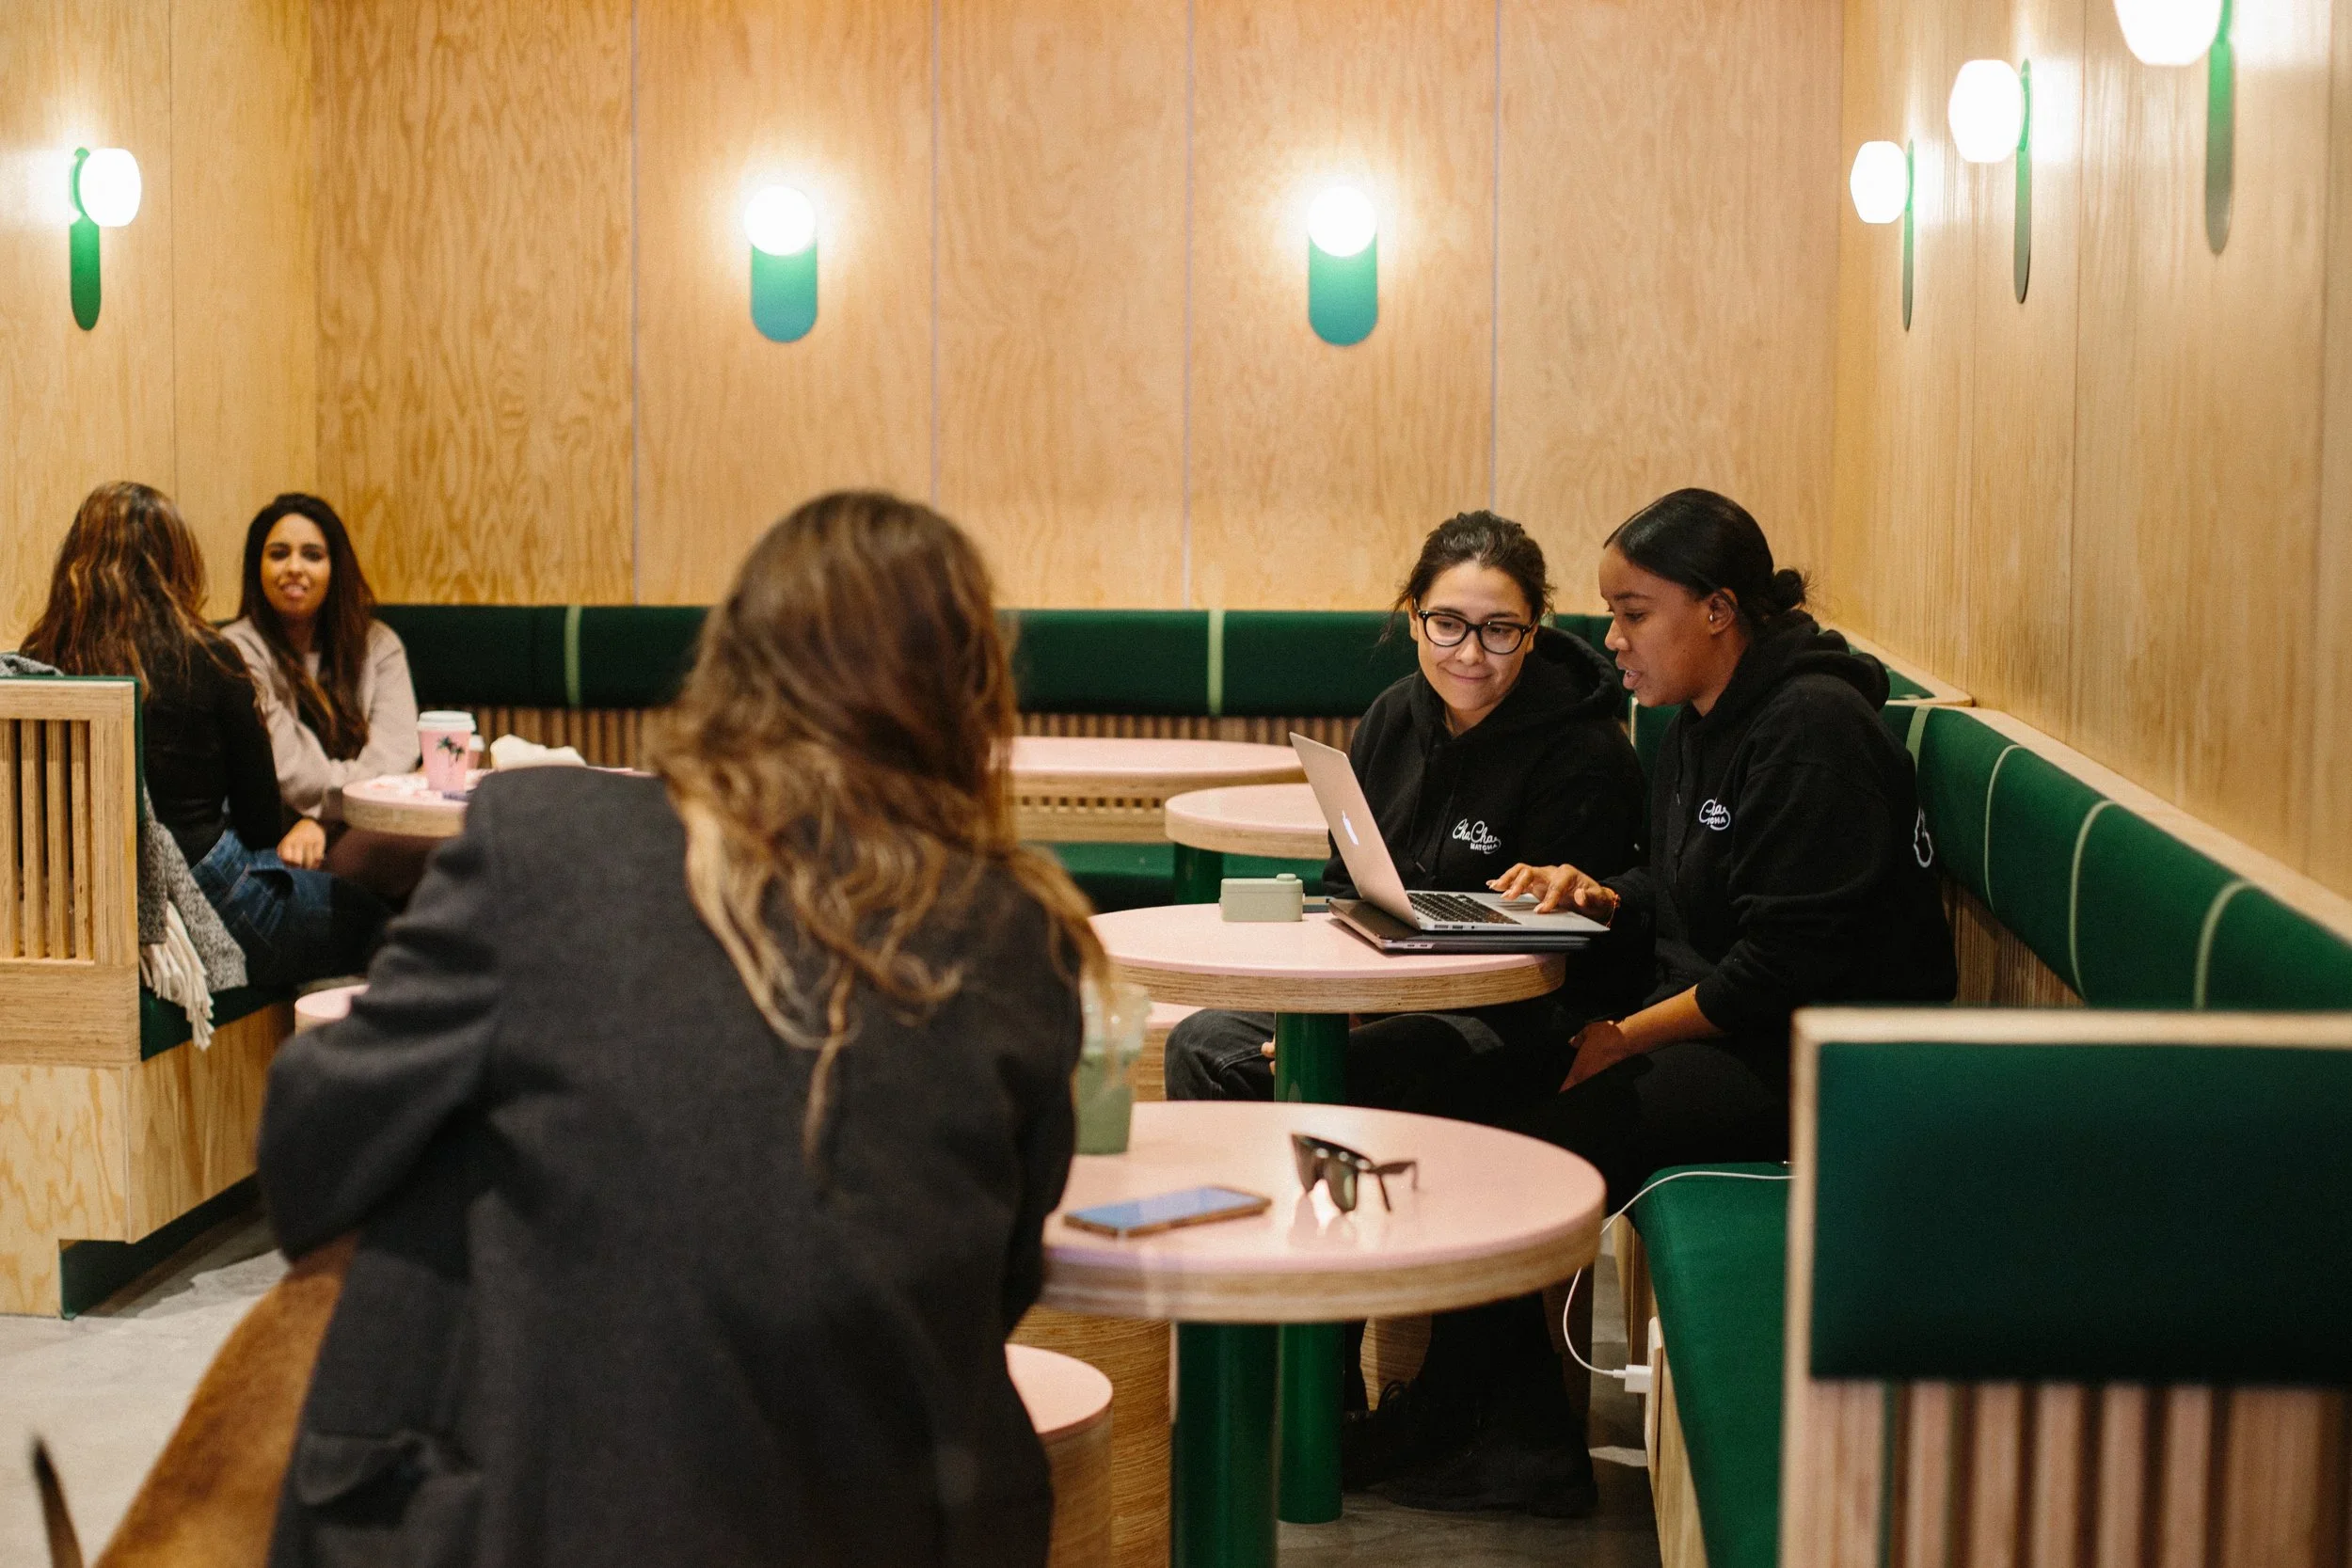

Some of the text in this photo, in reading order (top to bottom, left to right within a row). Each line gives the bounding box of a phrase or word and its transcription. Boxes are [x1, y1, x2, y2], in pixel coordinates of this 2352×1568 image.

[1452, 818, 1501, 848] Cha Cha
[1470, 843, 1498, 851] MATCHA
